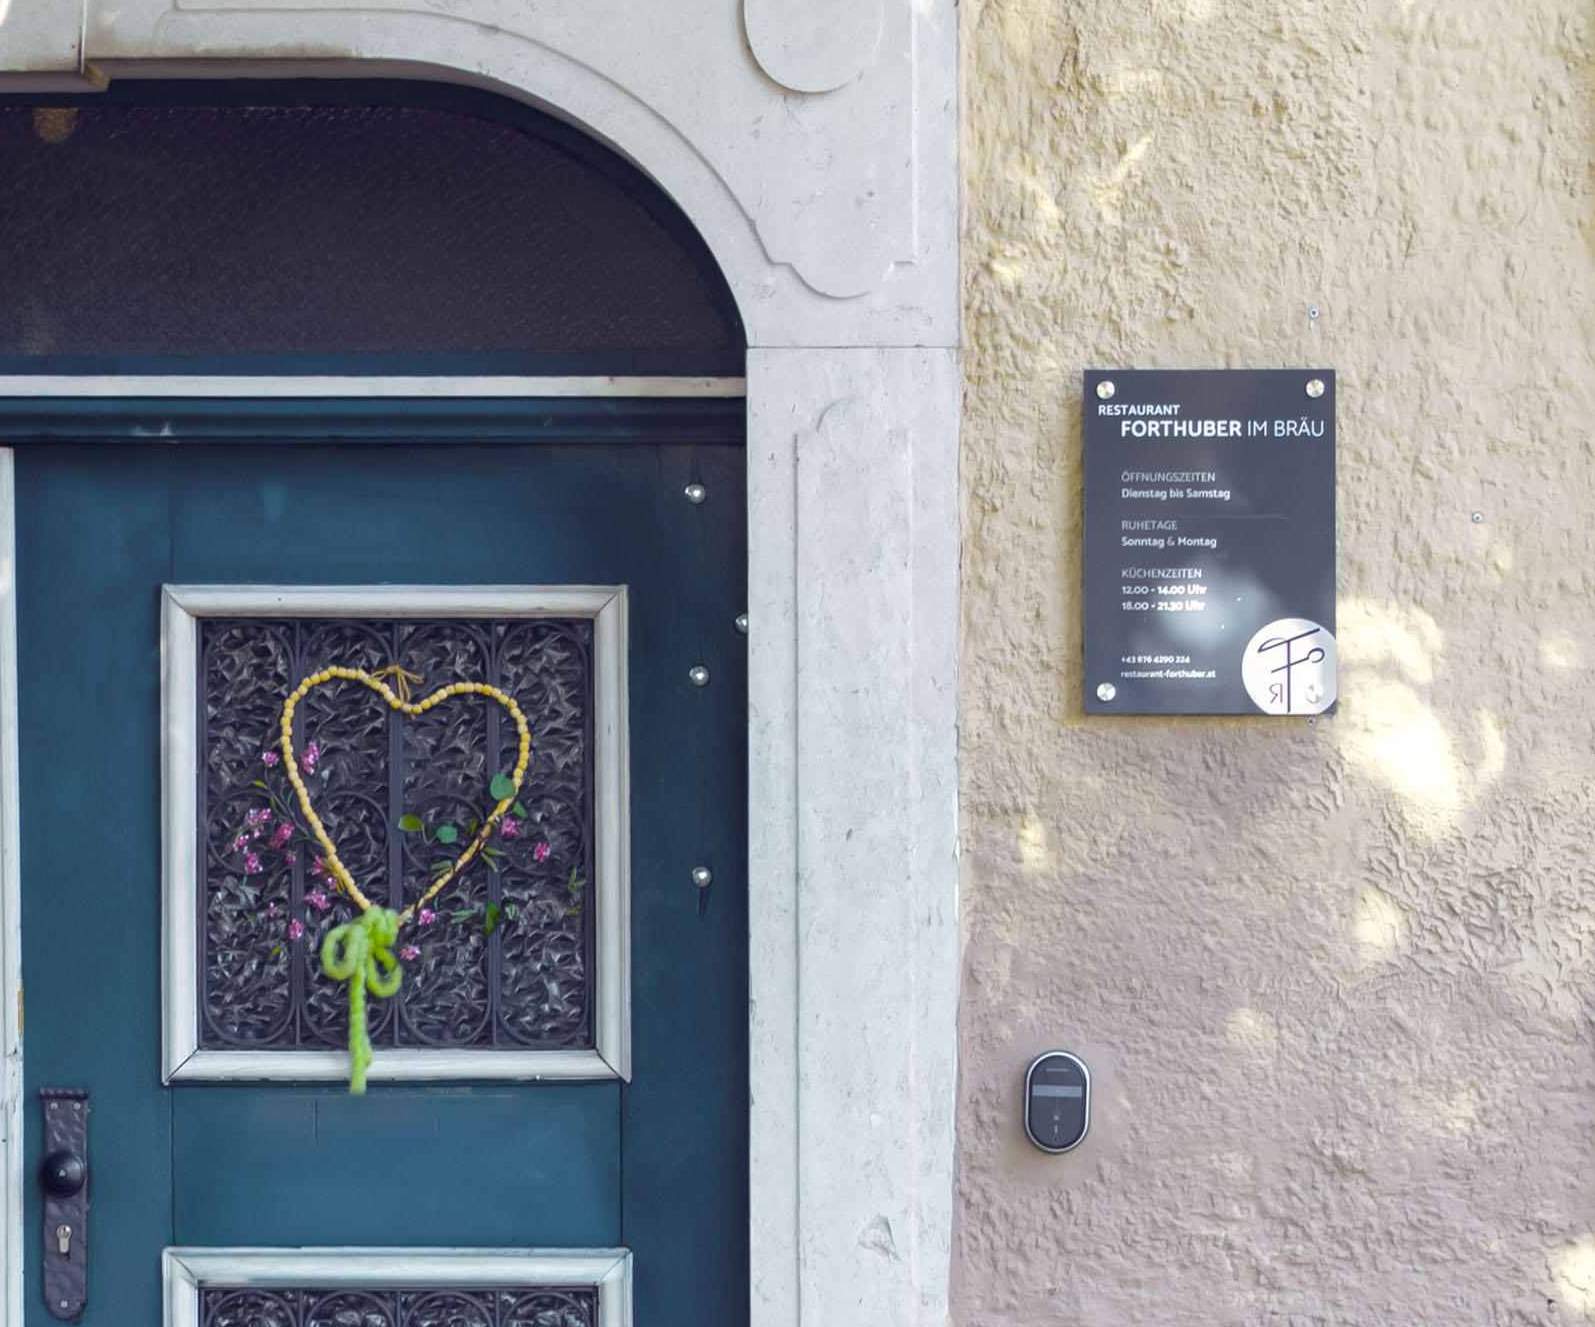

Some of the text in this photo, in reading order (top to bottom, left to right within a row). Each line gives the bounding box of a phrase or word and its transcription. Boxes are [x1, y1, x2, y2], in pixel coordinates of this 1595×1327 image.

[1098, 405, 1180, 416] RESTAURANT
[1121, 417, 1324, 437] FORTHUBER IM BRÄU
[1121, 470, 1216, 482] ÖFFNUNGSZEITEN
[1121, 488, 1231, 500] Dienstag bis Samstag
[1121, 521, 1178, 530] RUHETAGE
[1121, 537, 1217, 549] Sonntag & Montag
[1121, 567, 1202, 578] KÜCHENZEITEN
[1122, 586, 1149, 595] 12.00
[1157, 585, 1185, 595] 14.00
[1187, 584, 1207, 595] Uhr
[1121, 602, 1149, 611] 18.00
[1157, 601, 1184, 611] 21.30
[1185, 600, 1206, 611] Uhr
[1121, 669, 1216, 679] restaurant-forthuber.at
